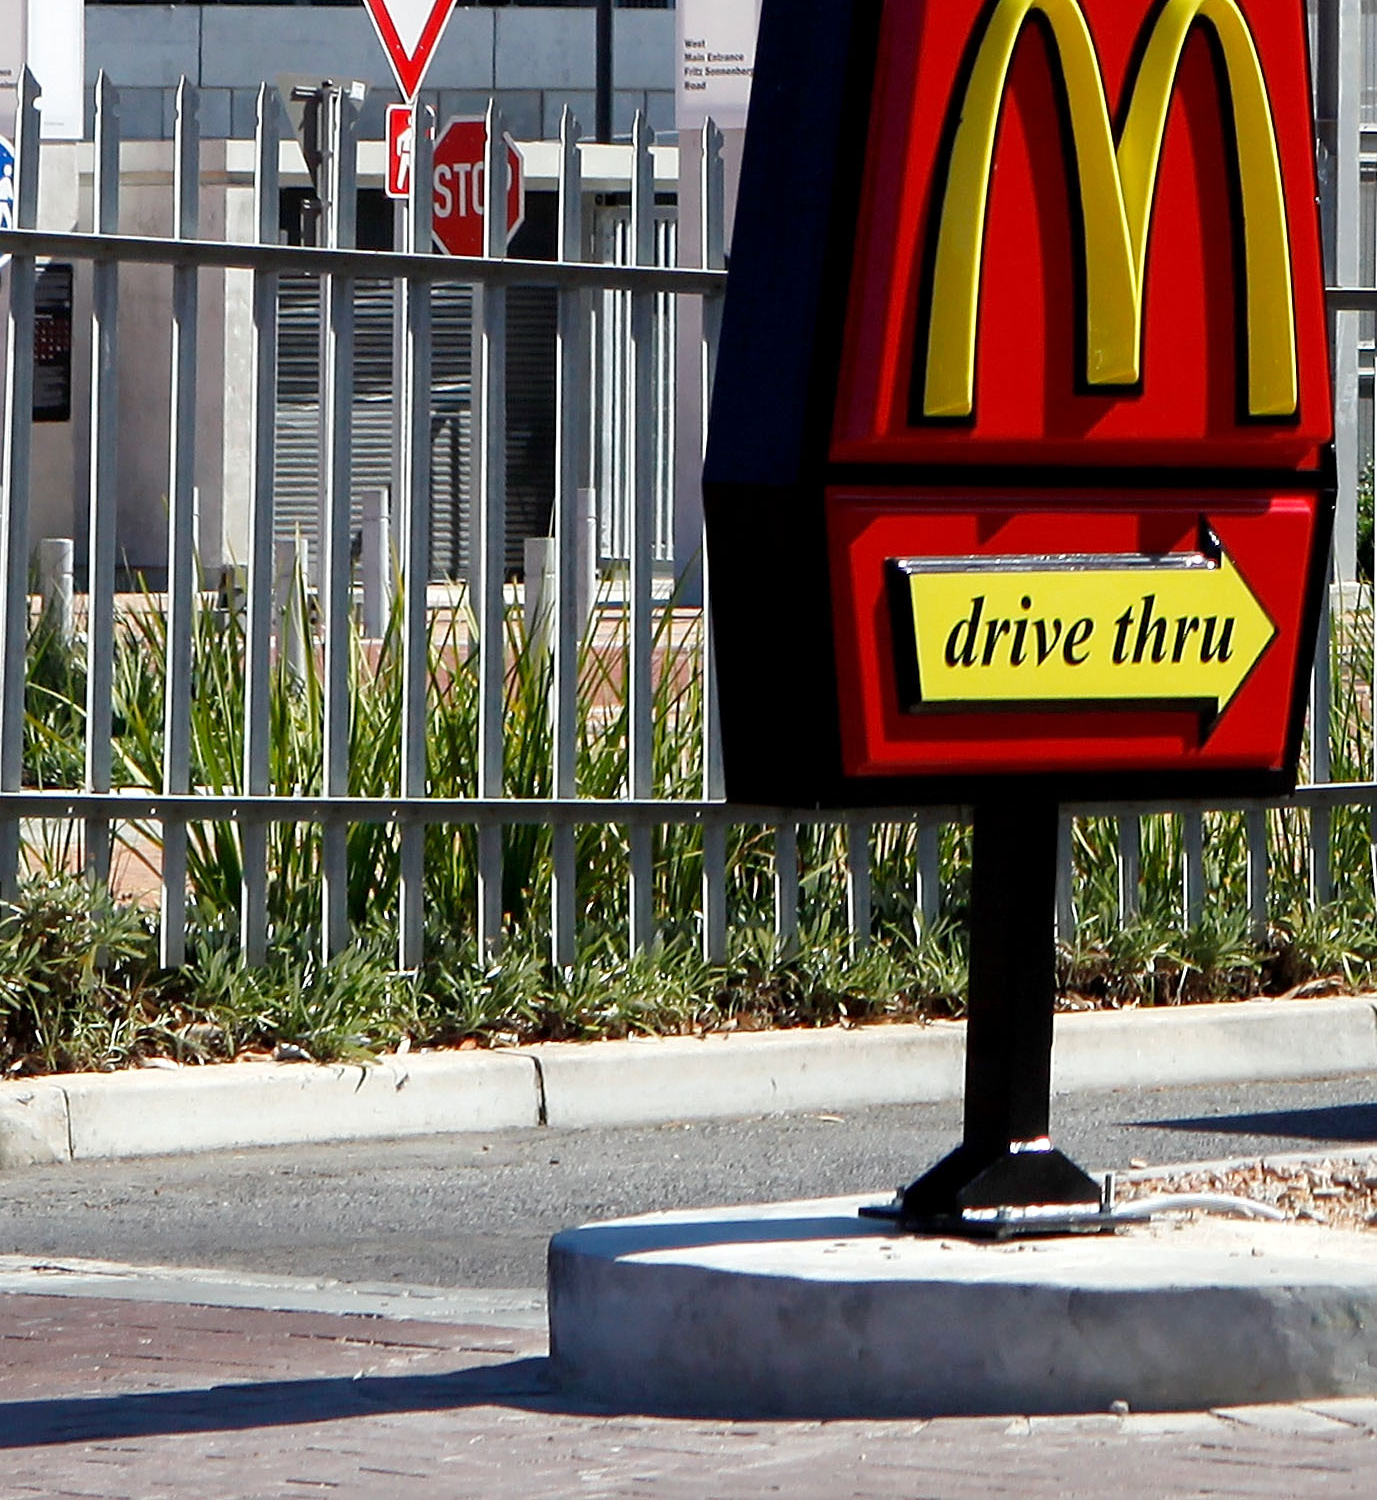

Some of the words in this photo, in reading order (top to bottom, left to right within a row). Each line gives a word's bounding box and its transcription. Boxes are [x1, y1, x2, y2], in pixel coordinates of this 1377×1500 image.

[684, 39, 706, 49] West
[707, 52, 745, 62] Entrance
[433, 162, 513, 219] STO
[944, 596, 1096, 667] drive
[1111, 594, 1236, 664] thru
